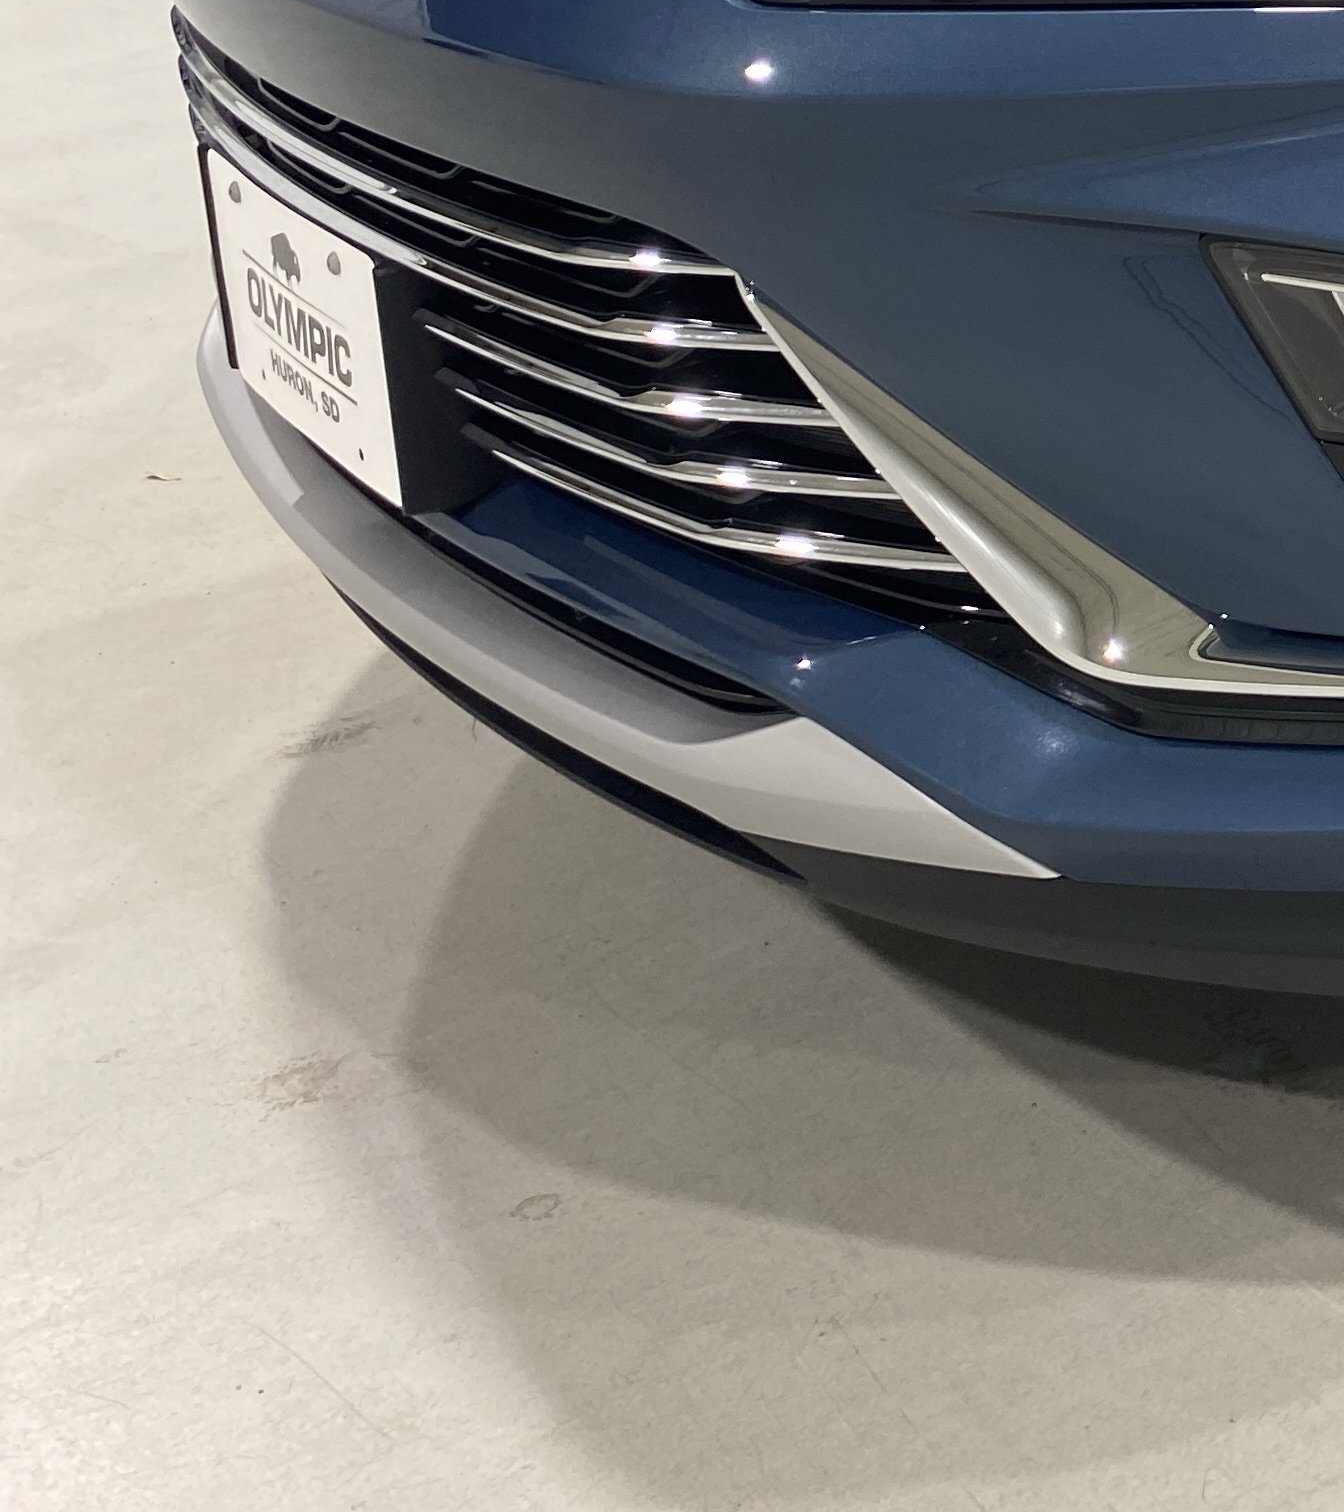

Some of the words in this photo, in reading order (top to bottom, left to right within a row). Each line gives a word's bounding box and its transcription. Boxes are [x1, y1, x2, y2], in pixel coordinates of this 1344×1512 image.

[247, 266, 353, 388] OLYMPIC
[270, 348, 319, 413] HURON,
[321, 390, 341, 424] SD
